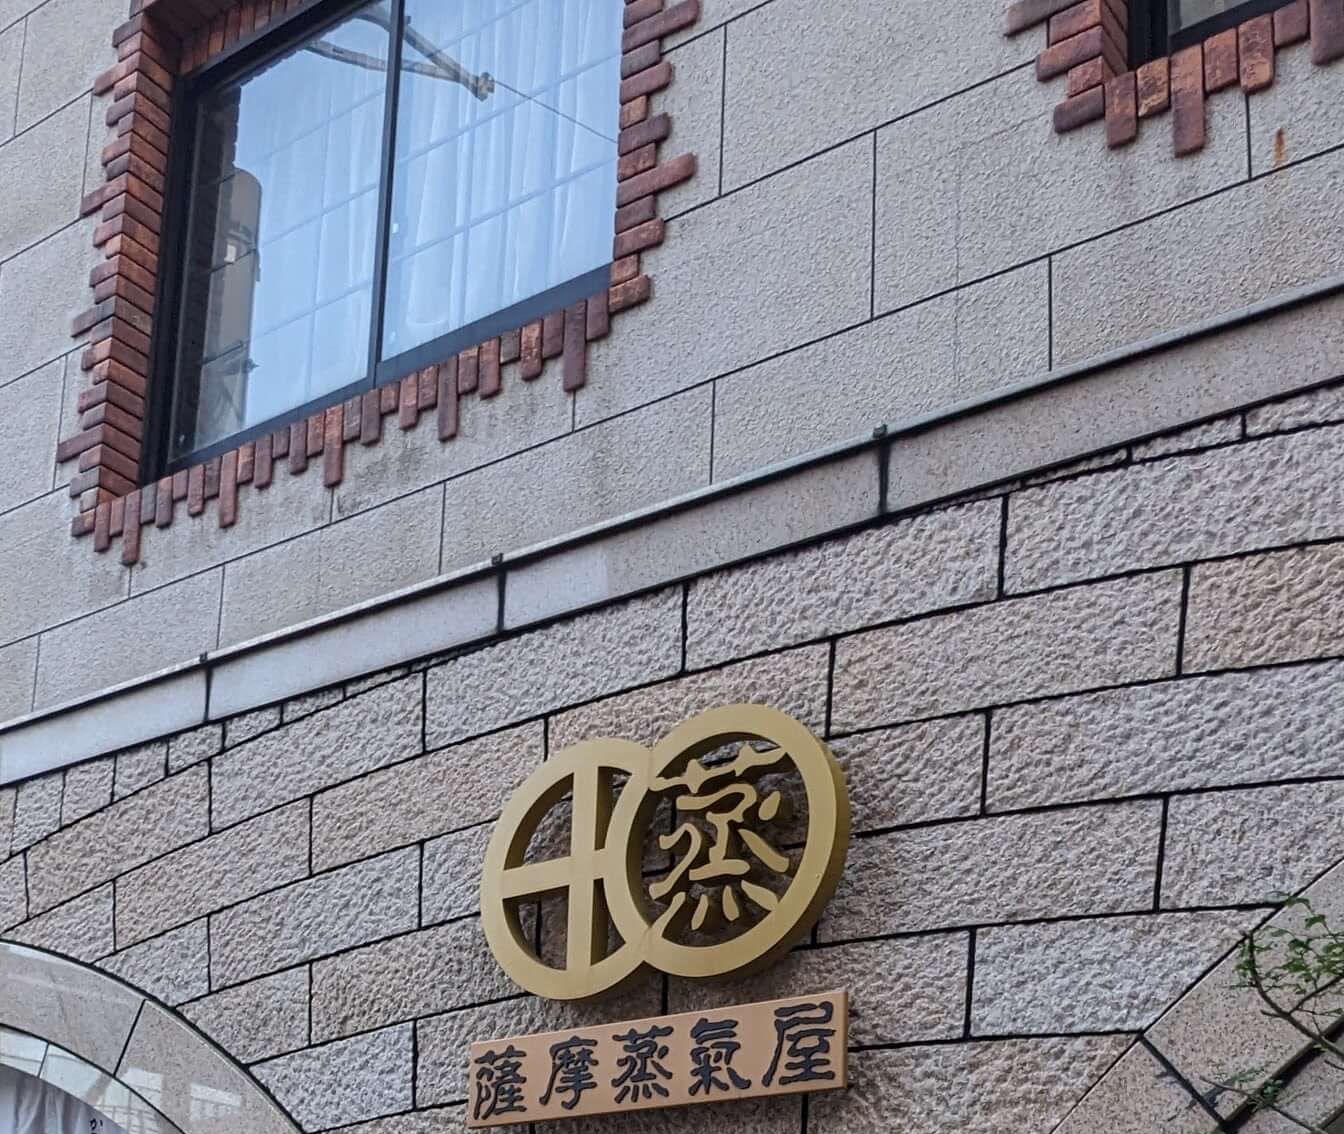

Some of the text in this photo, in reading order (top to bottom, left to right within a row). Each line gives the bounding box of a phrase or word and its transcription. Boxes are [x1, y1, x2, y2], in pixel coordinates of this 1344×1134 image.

[472, 1000, 837, 1121] 薩摩蒸氣屋
